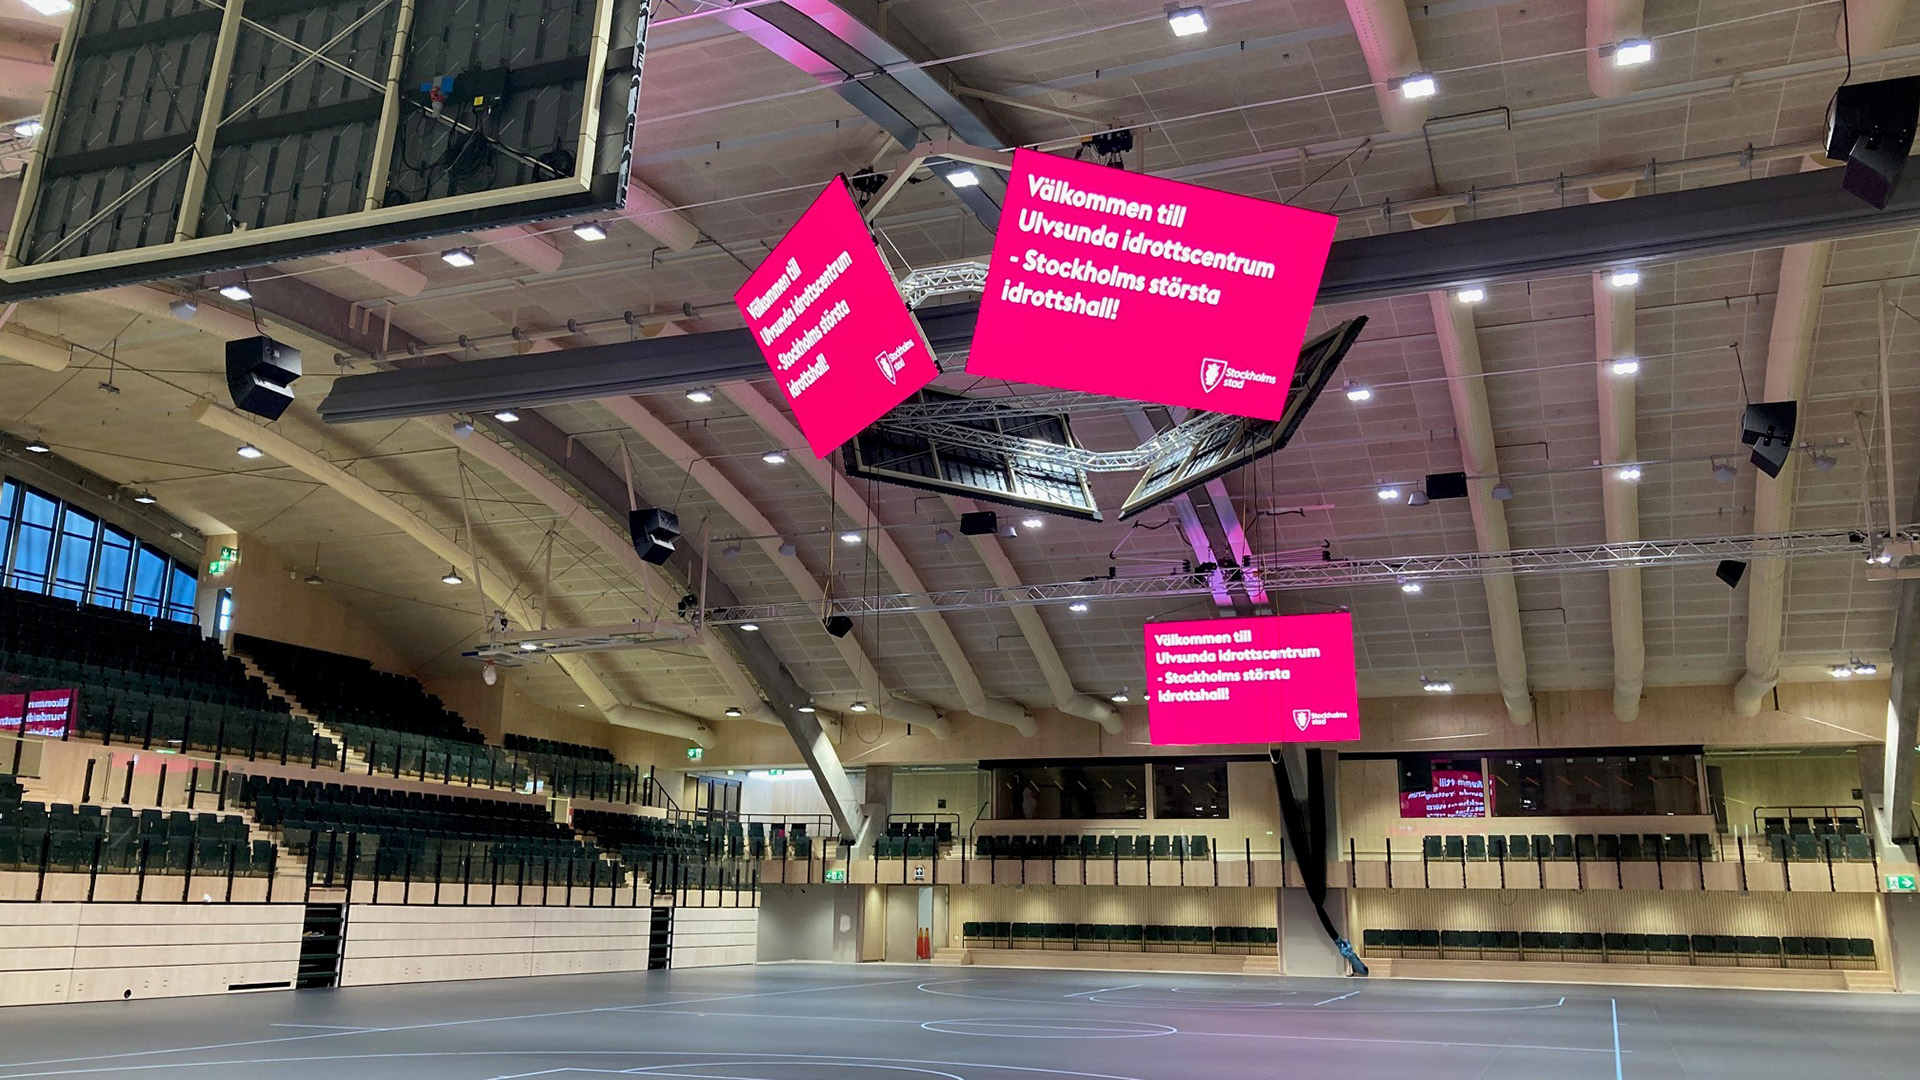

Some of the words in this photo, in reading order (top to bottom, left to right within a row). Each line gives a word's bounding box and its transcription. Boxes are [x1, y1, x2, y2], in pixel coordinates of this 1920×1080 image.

[1028, 174, 1152, 221] Välkommen
[1157, 203, 1187, 228] till
[1018, 209, 1119, 249] Ulvsunda
[1122, 229, 1275, 279] idrottscentrum
[746, 273, 792, 321] Välkommen
[786, 256, 802, 282] till
[1022, 249, 1146, 291] Stockholms
[1148, 277, 1221, 305] största
[759, 307, 797, 347] Ulvsunda
[790, 250, 853, 317] idrottscentrum
[1001, 279, 1121, 320] idrottshall!
[777, 325, 823, 371] Stockholms
[819, 299, 851, 335] största
[888, 338, 915, 363] Stockholms
[786, 352, 830, 399] idrottshall!
[893, 358, 906, 373] stad
[1225, 366, 1277, 385] Stockholms
[1223, 377, 1245, 390] stad
[1154, 633, 1232, 647] Välkommen
[1233, 630, 1252, 643] till
[1155, 650, 1216, 665] Ulvsunda
[1218, 647, 1320, 662] idrottscentrum
[1165, 670, 1241, 684] Stockholms
[1243, 668, 1291, 681] största
[1158, 687, 1230, 702] idrottshall!
[1311, 711, 1348, 719] Stockholms
